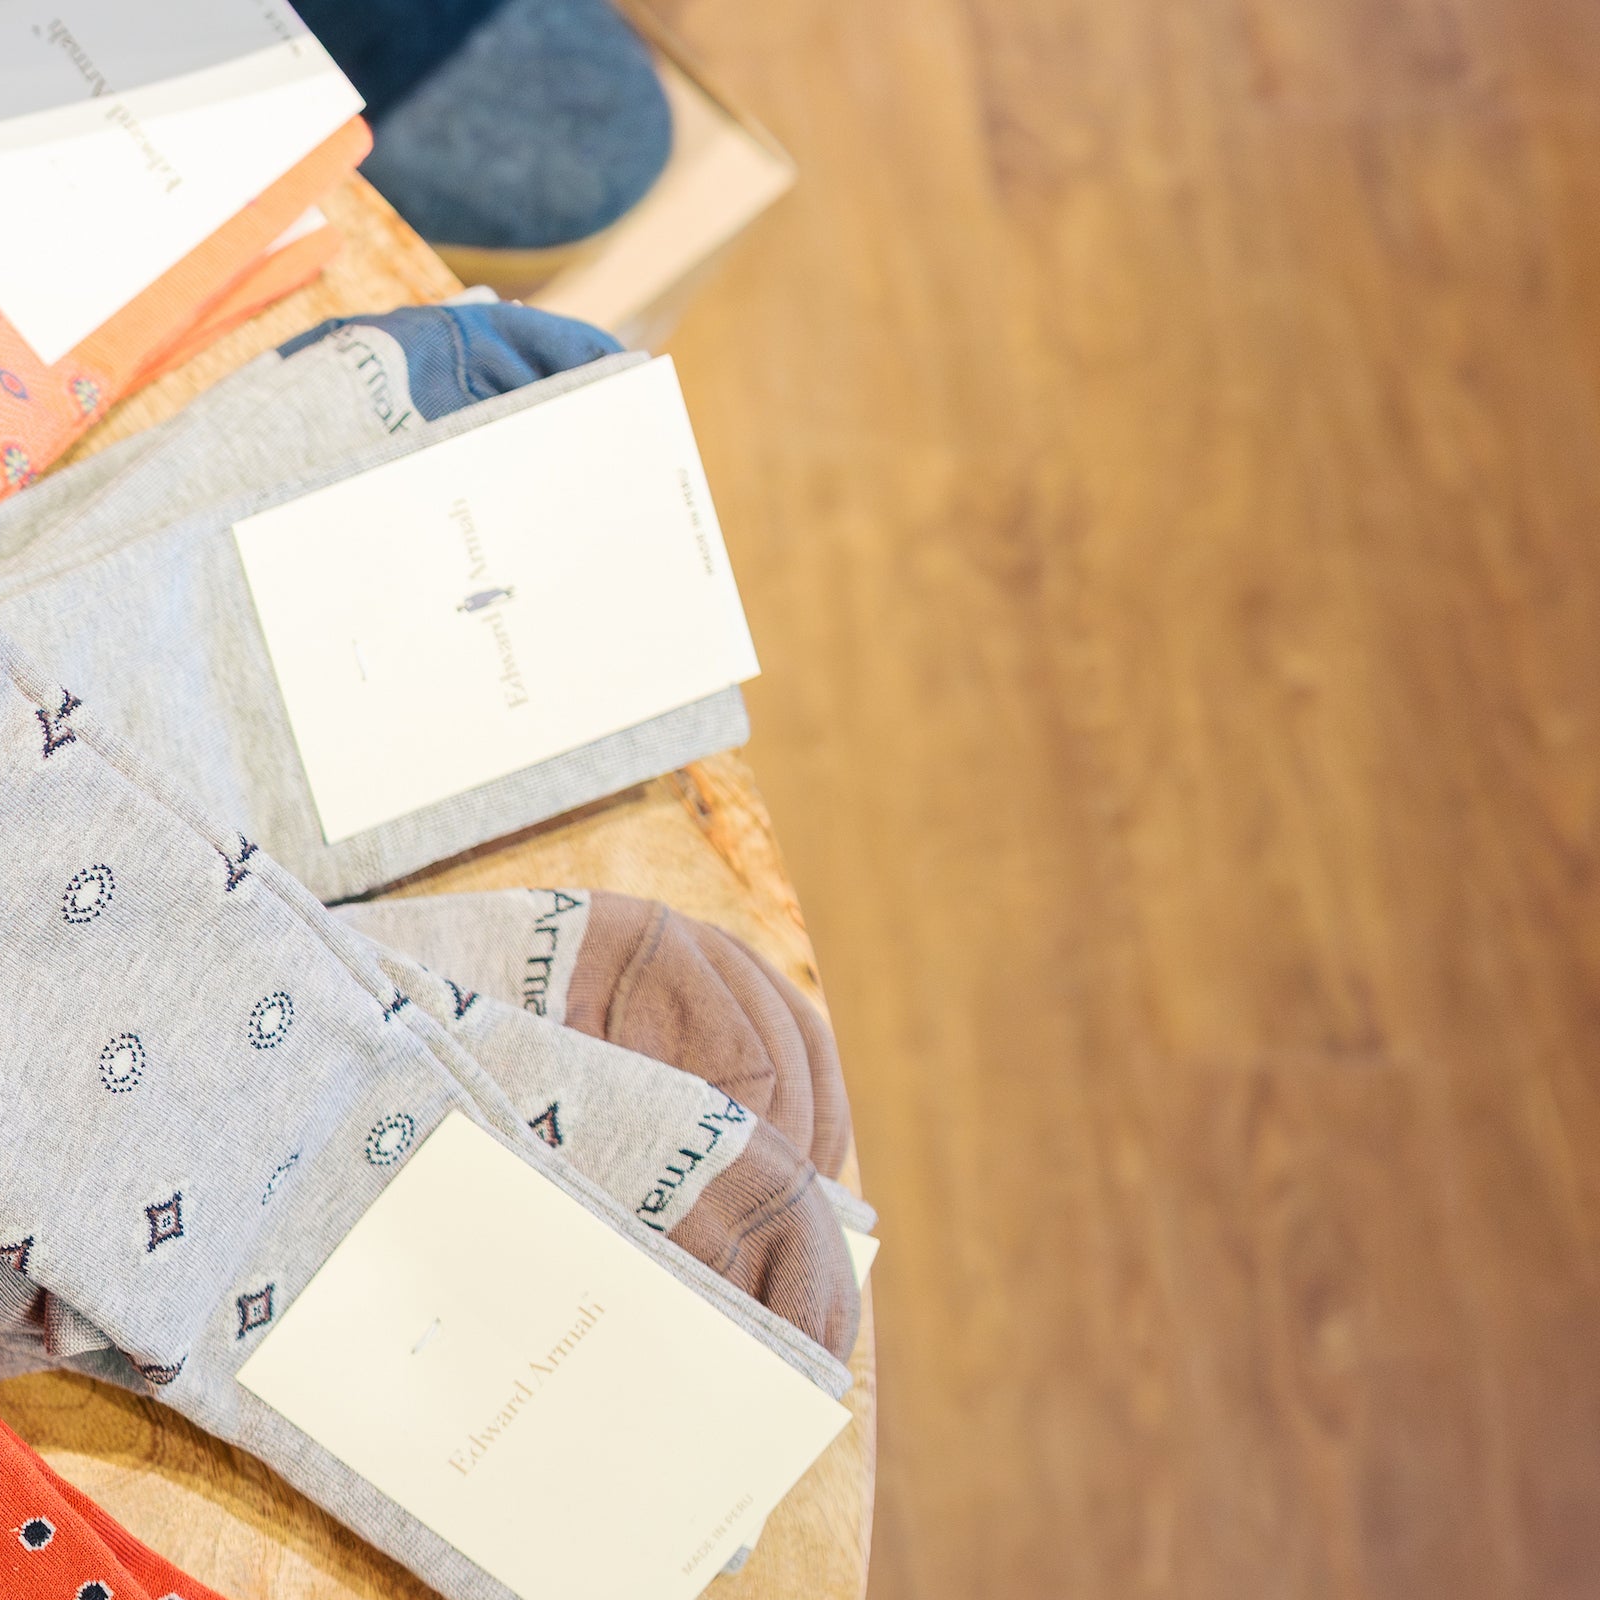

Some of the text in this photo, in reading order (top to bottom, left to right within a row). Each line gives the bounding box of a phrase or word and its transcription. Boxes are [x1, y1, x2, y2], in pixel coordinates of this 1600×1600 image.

[522, 888, 583, 1019] Arma
[448, 1301, 606, 1477] Edward Armah
